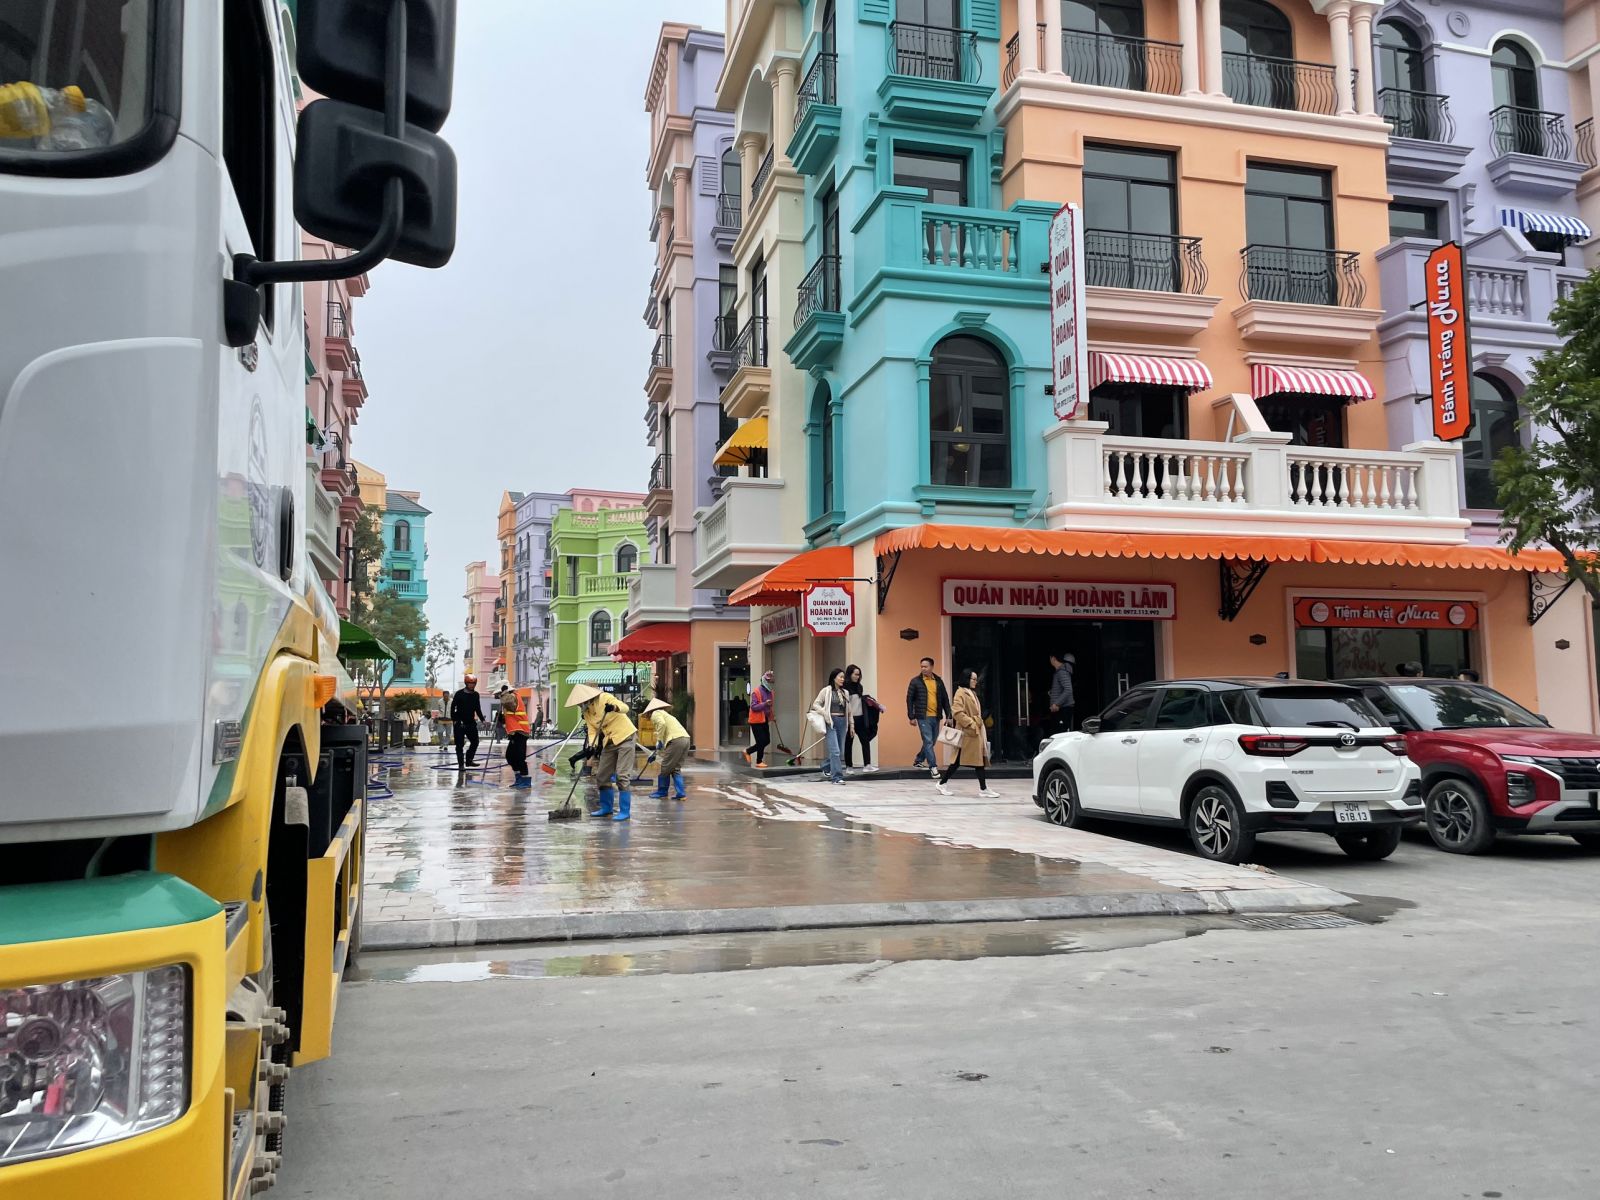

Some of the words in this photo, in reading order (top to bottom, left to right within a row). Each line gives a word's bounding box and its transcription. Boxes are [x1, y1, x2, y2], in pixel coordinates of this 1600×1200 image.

[1054, 246, 1070, 276] QUÁN
[1055, 280, 1071, 308] NHẬU
[1430, 259, 1458, 325] Nuna
[1055, 317, 1074, 347] HOÀNG
[1059, 355, 1072, 380] LÂM
[1438, 329, 1455, 381] Tráng
[1441, 380, 1456, 424] Bánh
[810, 606, 833, 616] HOÀNG
[834, 606, 849, 616] LÂM
[953, 583, 1004, 607] QUÁN
[1010, 584, 1059, 611] NHẬU
[1064, 586, 1125, 608] HOÀNG
[1131, 587, 1168, 609] LÂM
[1334, 606, 1361, 621] Tiệm
[1363, 607, 1377, 619] ăn
[1378, 606, 1394, 622] vặt
[1340, 812, 1368, 821] 618.13
[1344, 803, 1359, 812] 30H
